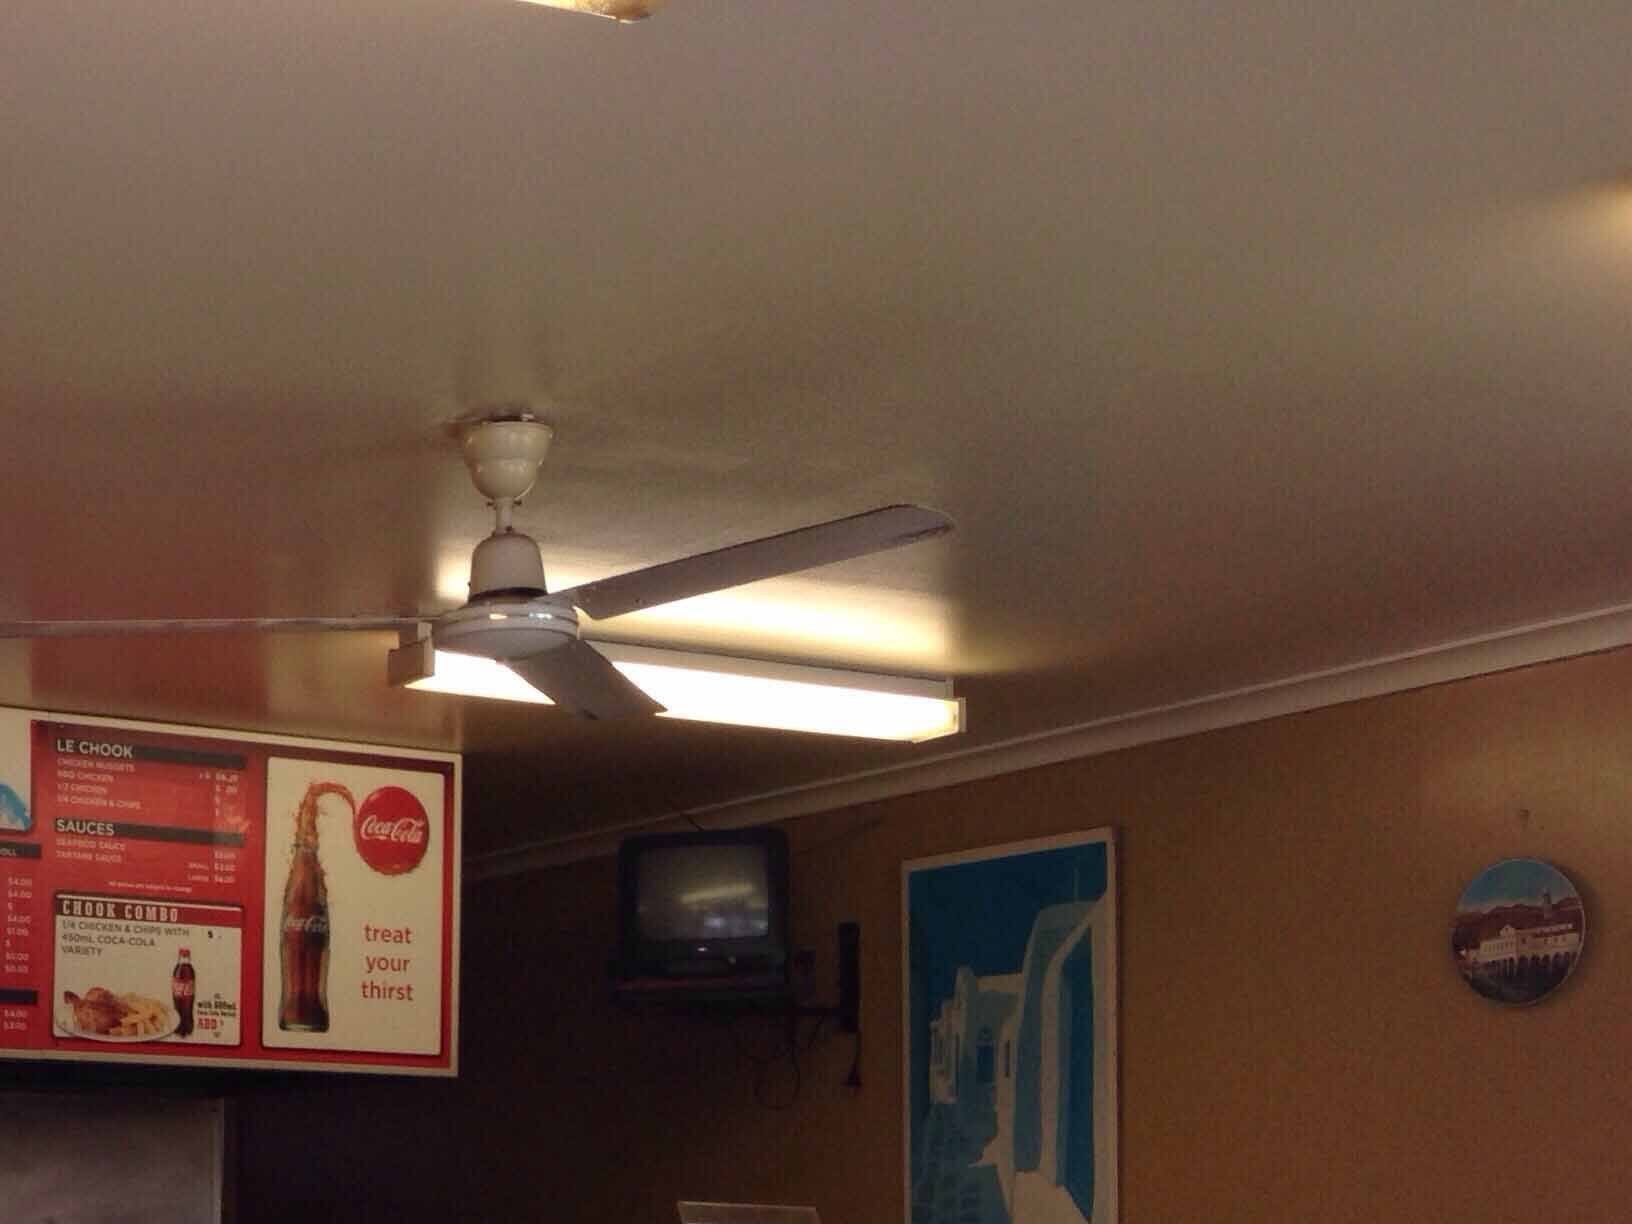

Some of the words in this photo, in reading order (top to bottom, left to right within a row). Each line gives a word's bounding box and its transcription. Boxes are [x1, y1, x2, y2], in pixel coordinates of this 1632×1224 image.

[57, 740, 76, 753] LE
[79, 741, 133, 759] CHOOK
[56, 819, 115, 836] SAUCES
[359, 814, 424, 845] Coca-Cola
[62, 900, 117, 919] CHOOK
[124, 905, 179, 922] COMBO
[364, 924, 411, 944] treat
[365, 957, 410, 974] your
[361, 981, 414, 1002] thirst
